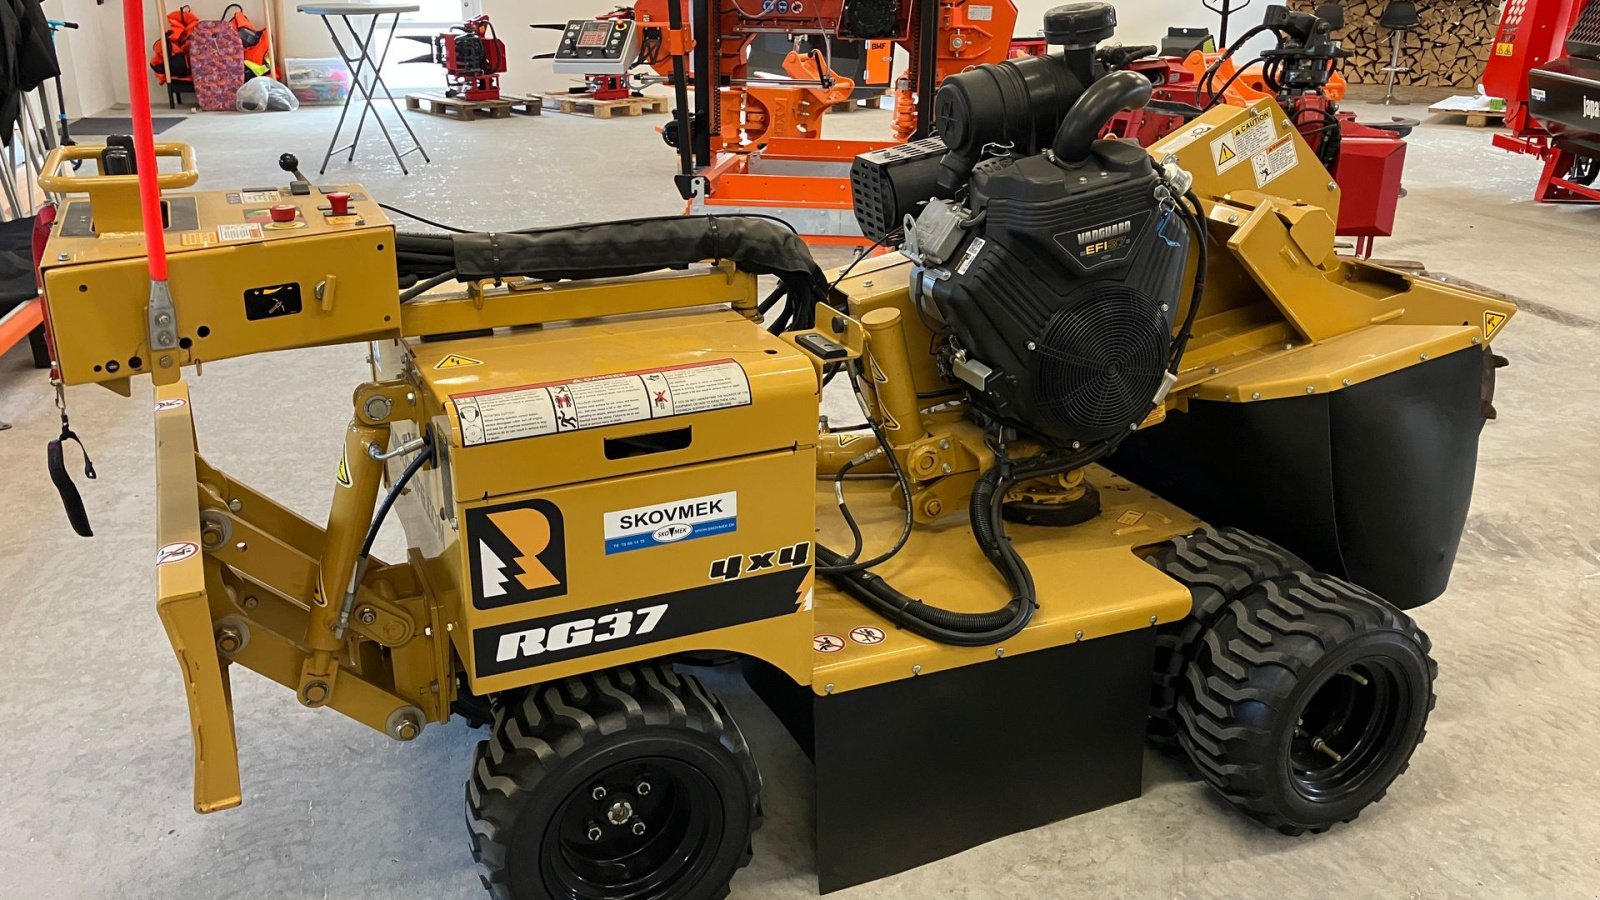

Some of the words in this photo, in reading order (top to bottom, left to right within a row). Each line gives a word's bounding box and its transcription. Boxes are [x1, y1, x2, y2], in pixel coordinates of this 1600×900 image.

[1241, 111, 1269, 132] CAUTION
[1077, 220, 1131, 246] VANGUARD
[620, 499, 723, 530] SKOVMEK
[709, 541, 811, 581] 4x4
[496, 603, 669, 663] RG37
